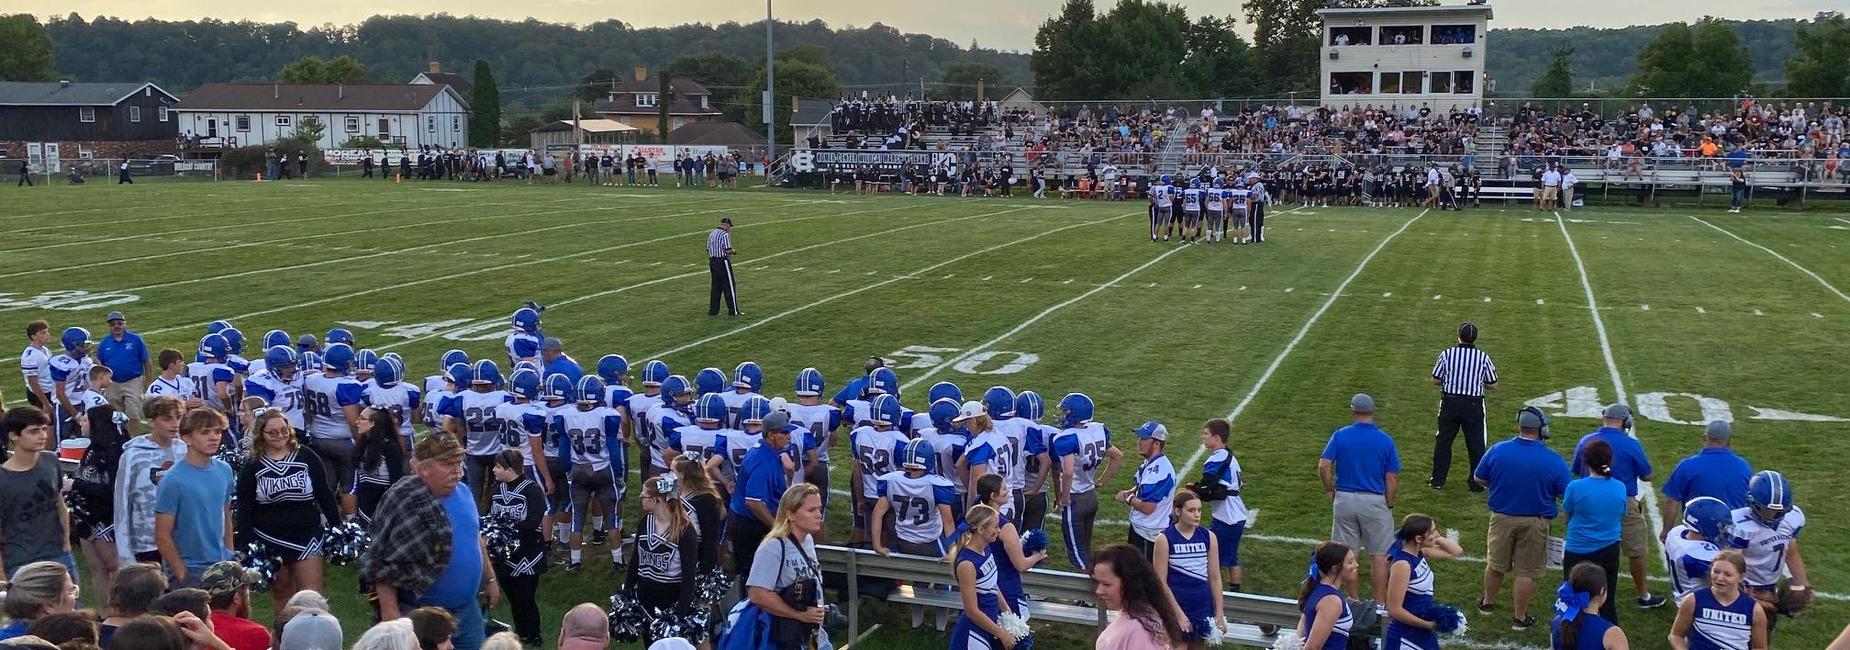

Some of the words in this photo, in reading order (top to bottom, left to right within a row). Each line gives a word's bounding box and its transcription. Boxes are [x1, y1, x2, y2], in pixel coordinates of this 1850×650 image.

[1157, 189, 1164, 200] 2
[1186, 193, 1197, 204] 65
[1208, 192, 1220, 203] 66
[884, 344, 1040, 375] 50
[304, 388, 332, 417] 68
[1524, 386, 1734, 425] 40
[465, 406, 501, 433] 22
[568, 427, 601, 456] 33
[860, 445, 890, 478] 52
[258, 470, 307, 496] VIKINGS
[893, 495, 930, 526] 73
[1173, 543, 1206, 554] UNITED
[1772, 542, 1785, 573] 7
[1702, 607, 1747, 624] UNITED
